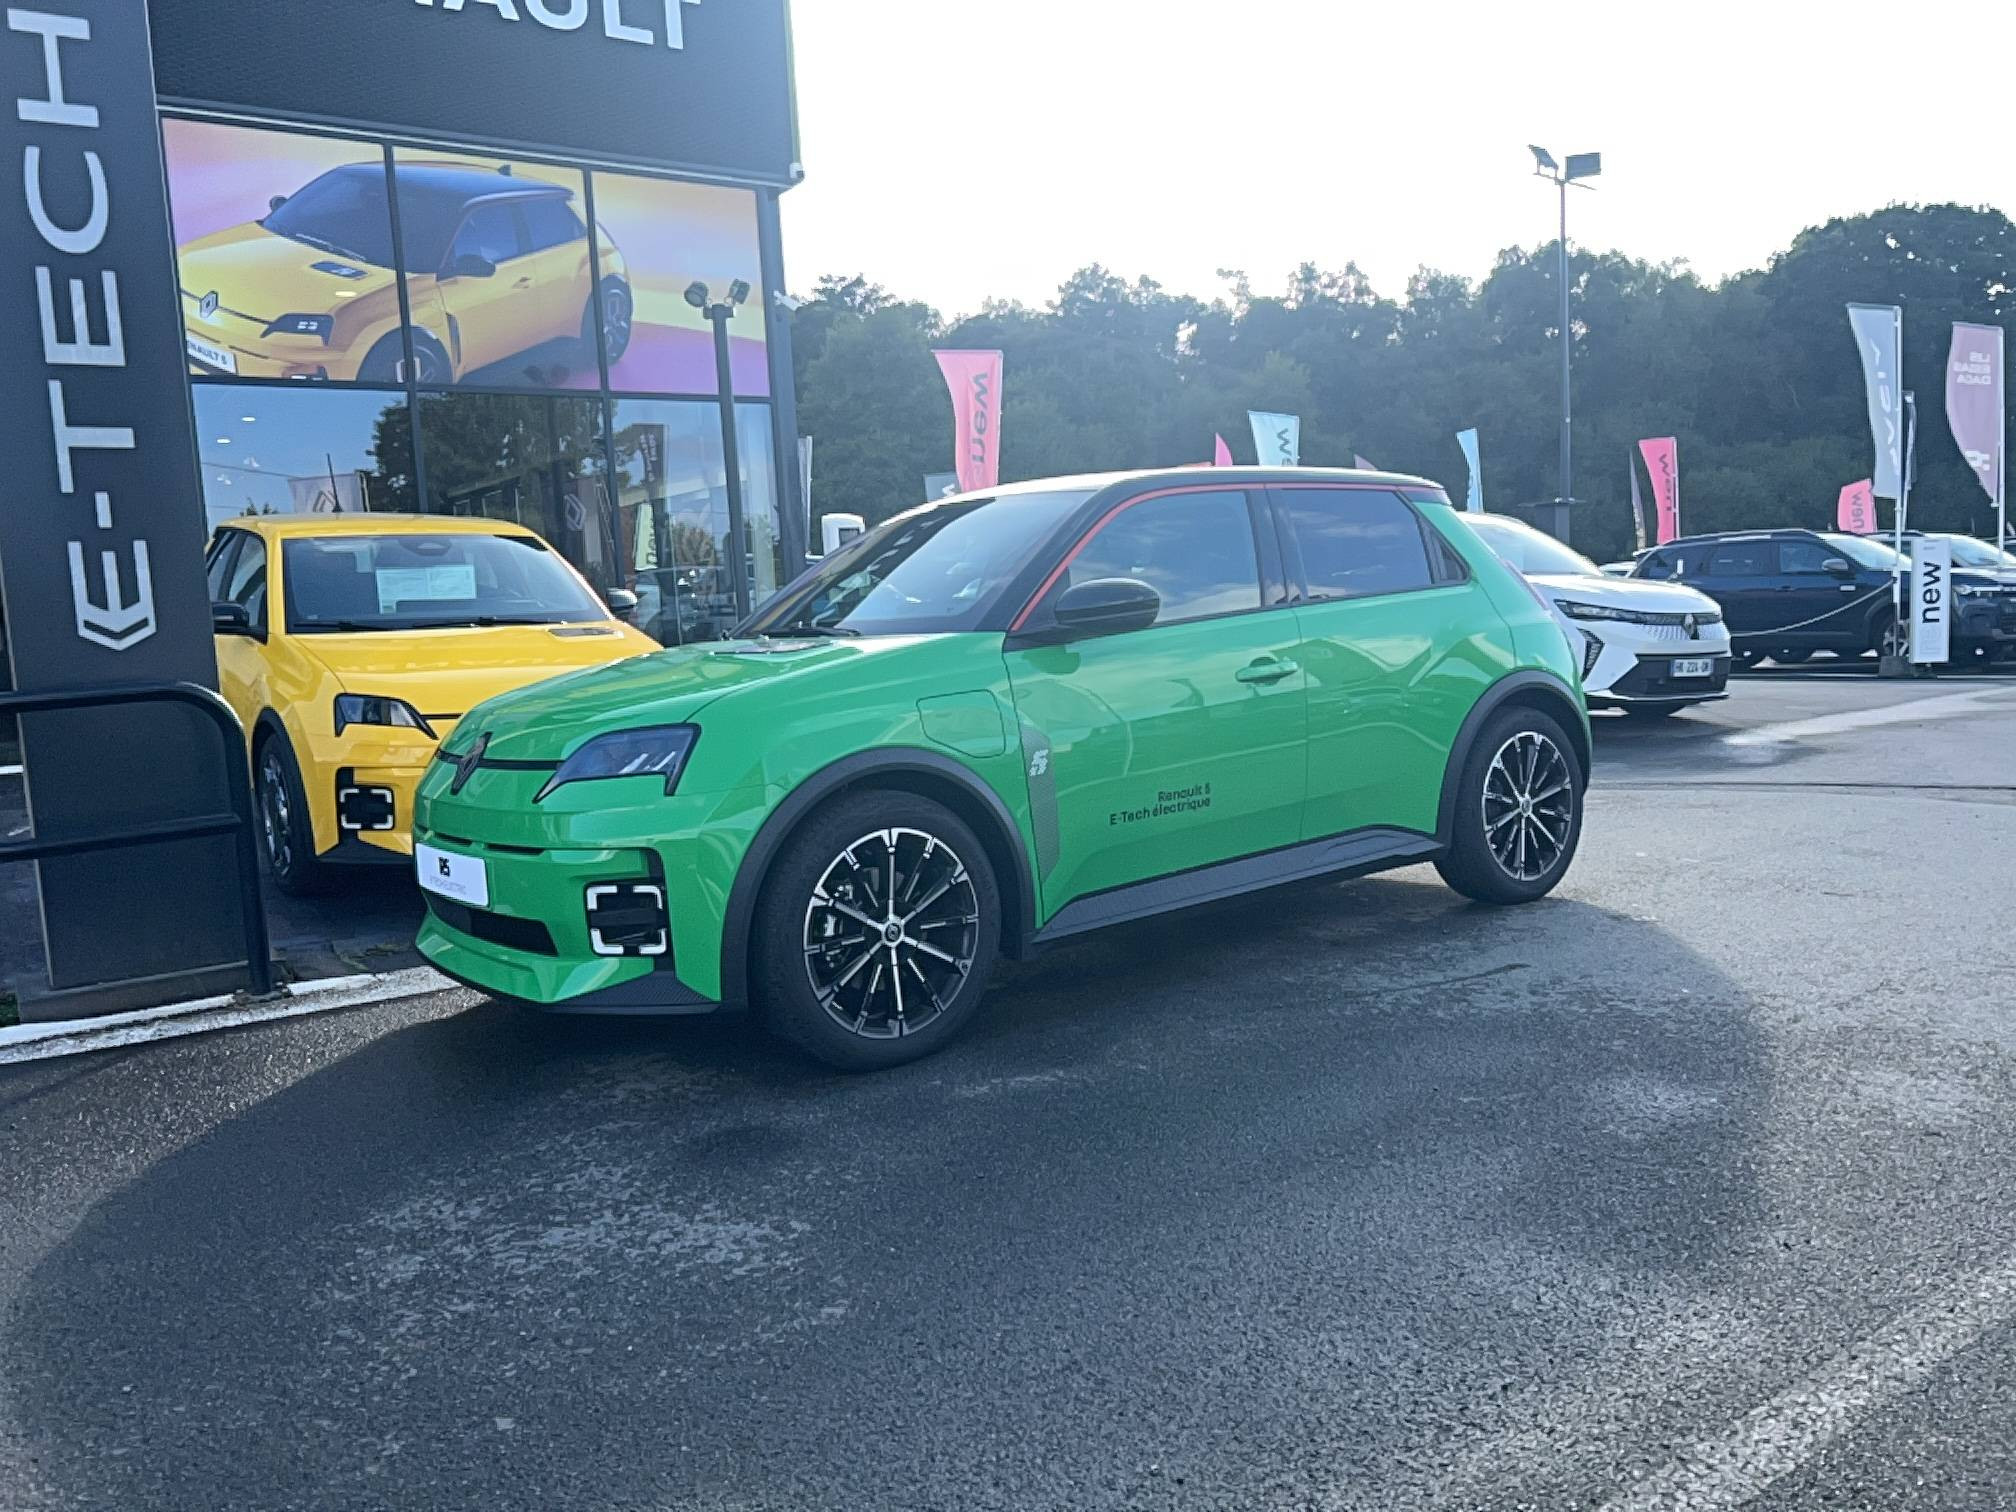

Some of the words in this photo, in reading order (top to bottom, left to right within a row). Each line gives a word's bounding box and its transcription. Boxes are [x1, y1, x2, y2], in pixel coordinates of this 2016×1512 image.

[6, 8, 157, 651] E-TECH
[1158, 784, 1203, 802] Renault
[1109, 807, 1150, 826] E-Tech
[1152, 797, 1211, 818] électrique
